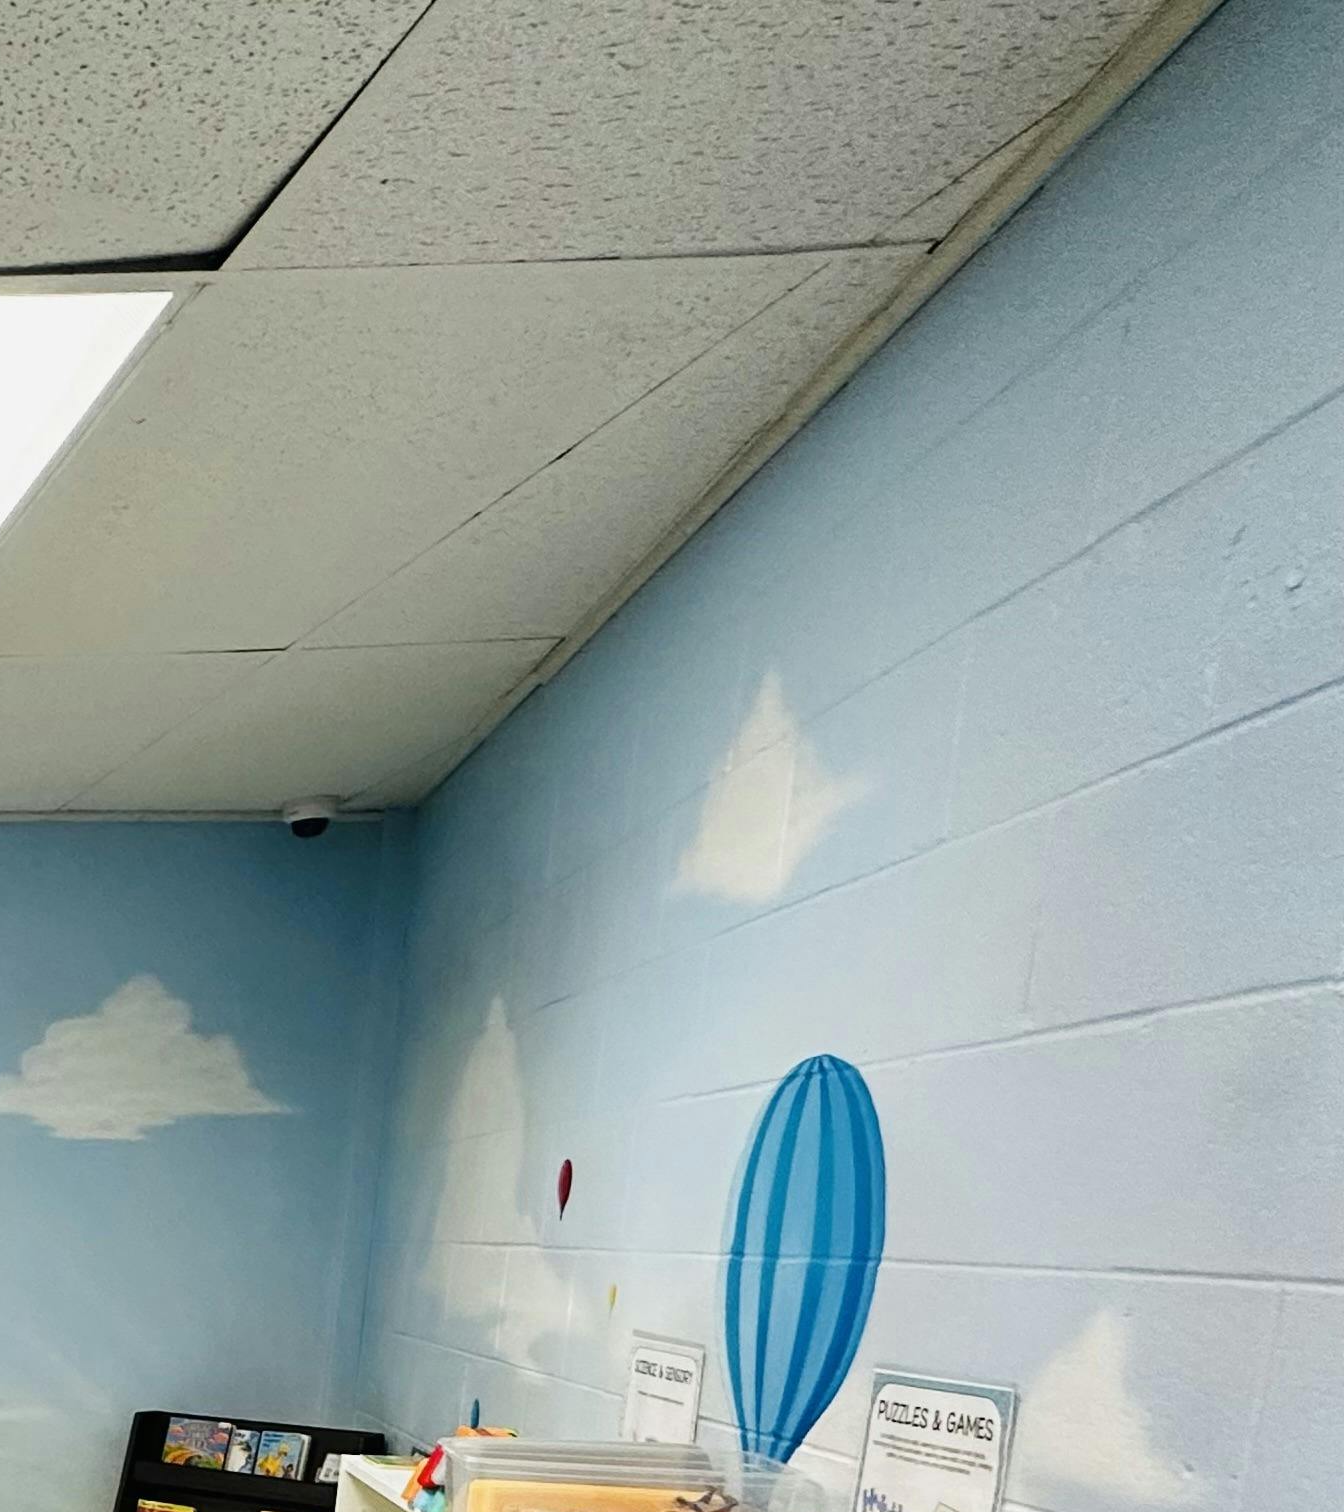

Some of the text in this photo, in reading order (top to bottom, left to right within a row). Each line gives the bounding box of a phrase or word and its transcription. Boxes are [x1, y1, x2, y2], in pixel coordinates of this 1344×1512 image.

[878, 1399, 994, 1441] PUZZLES & GAMES
